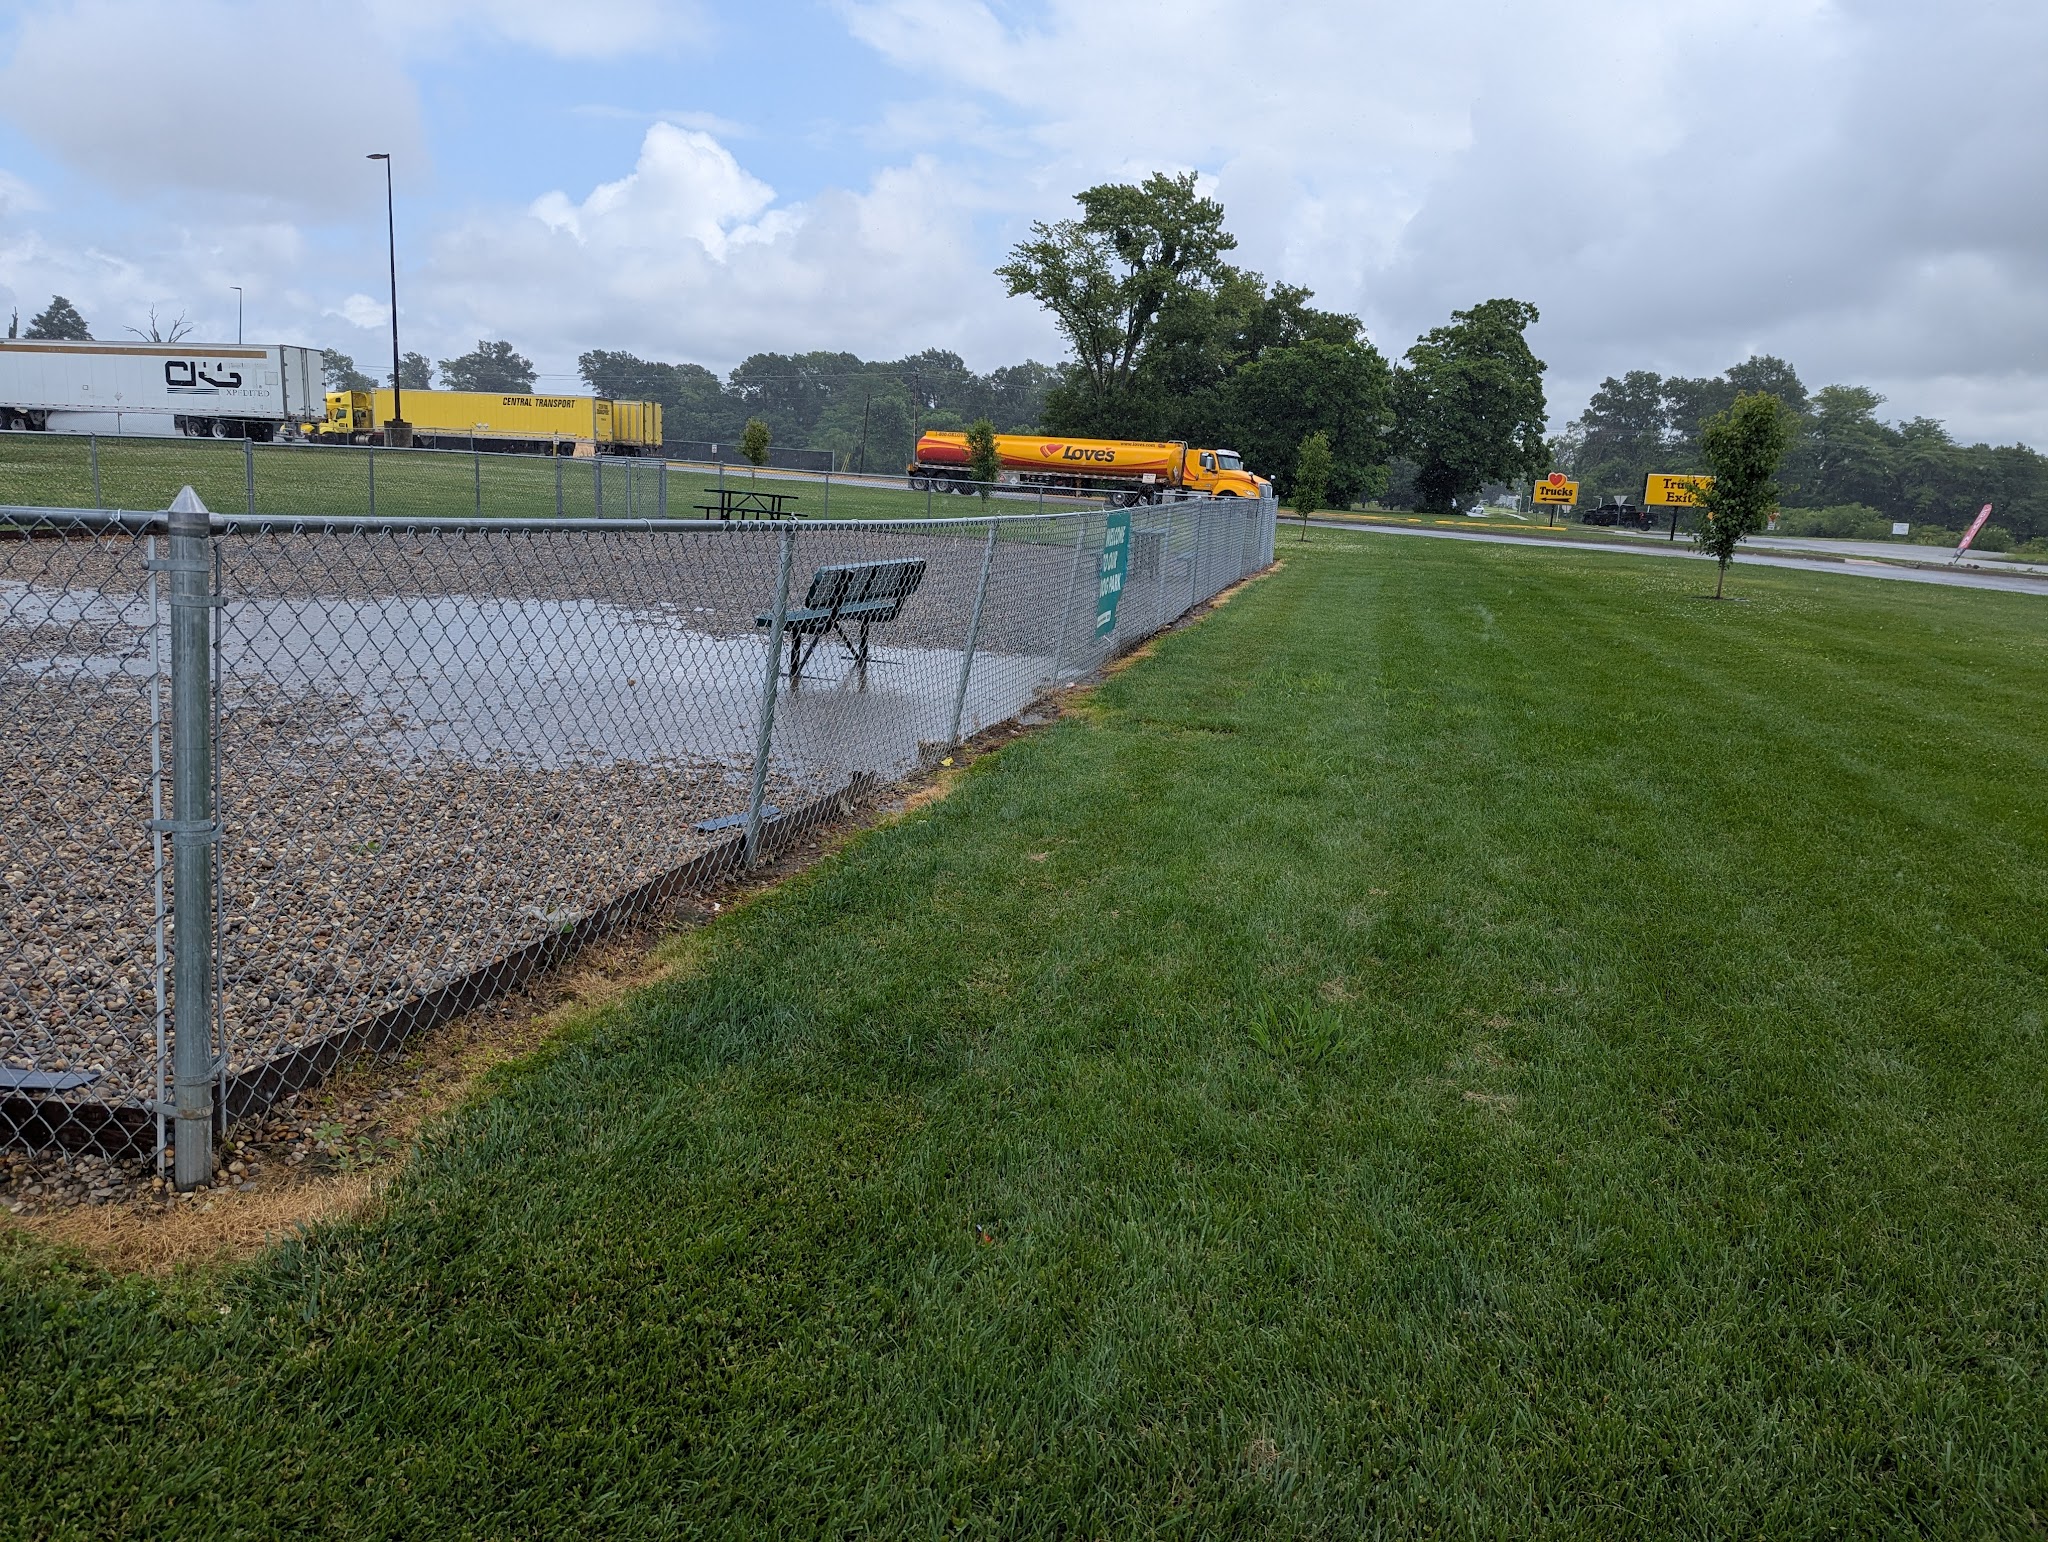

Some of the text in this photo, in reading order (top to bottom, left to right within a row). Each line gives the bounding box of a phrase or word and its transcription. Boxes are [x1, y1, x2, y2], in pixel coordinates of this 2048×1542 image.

[503, 397, 576, 409] CENTRAL TRANSPORT
[1663, 478, 1700, 490] Truk
[1540, 486, 1573, 496] Trucks
[1666, 492, 1693, 503] Exit
